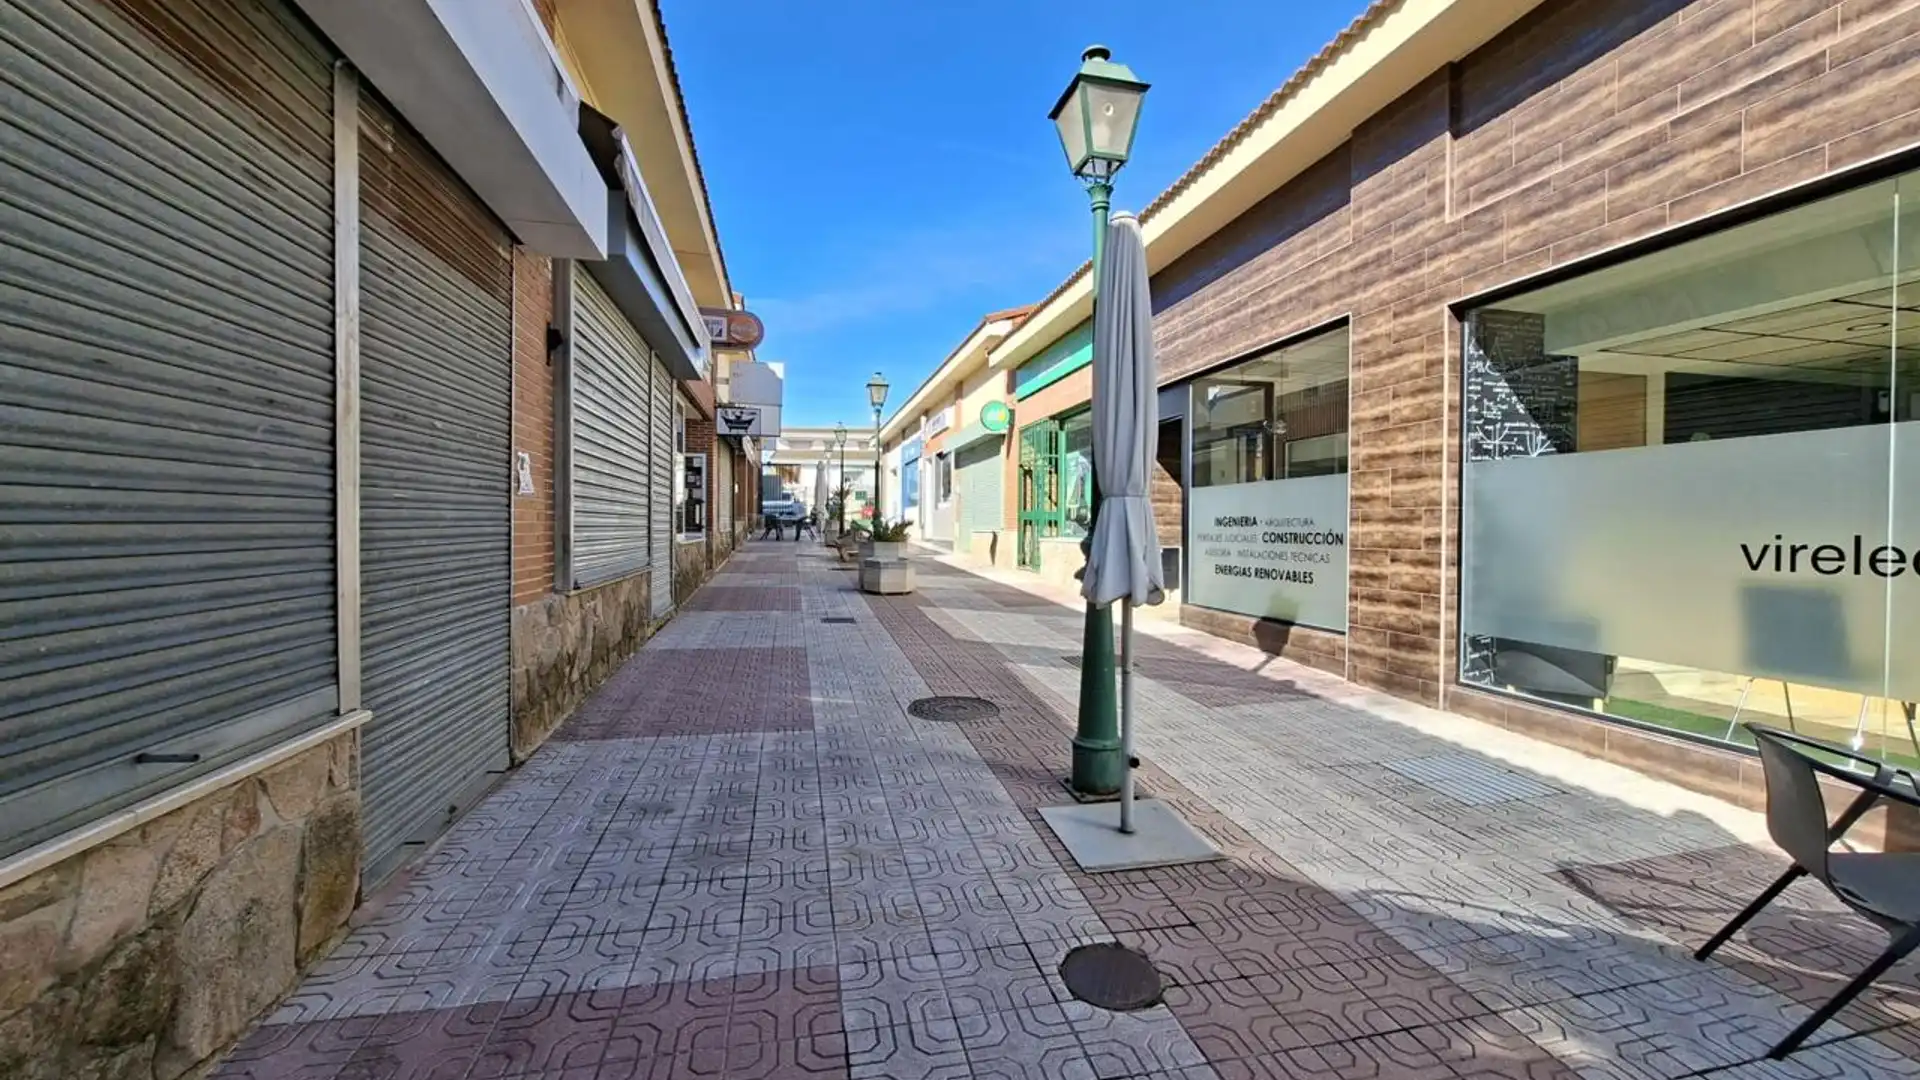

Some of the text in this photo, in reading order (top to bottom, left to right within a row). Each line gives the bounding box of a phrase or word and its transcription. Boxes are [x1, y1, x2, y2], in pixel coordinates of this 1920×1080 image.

[1214, 516, 1315, 528] INGENIERIA ARQUITECTURA
[1262, 528, 1344, 546] CONSTRUCCIÓN
[1740, 534, 1920, 578] virele
[1214, 563, 1315, 585] ENERGIAS RENOVABLES
